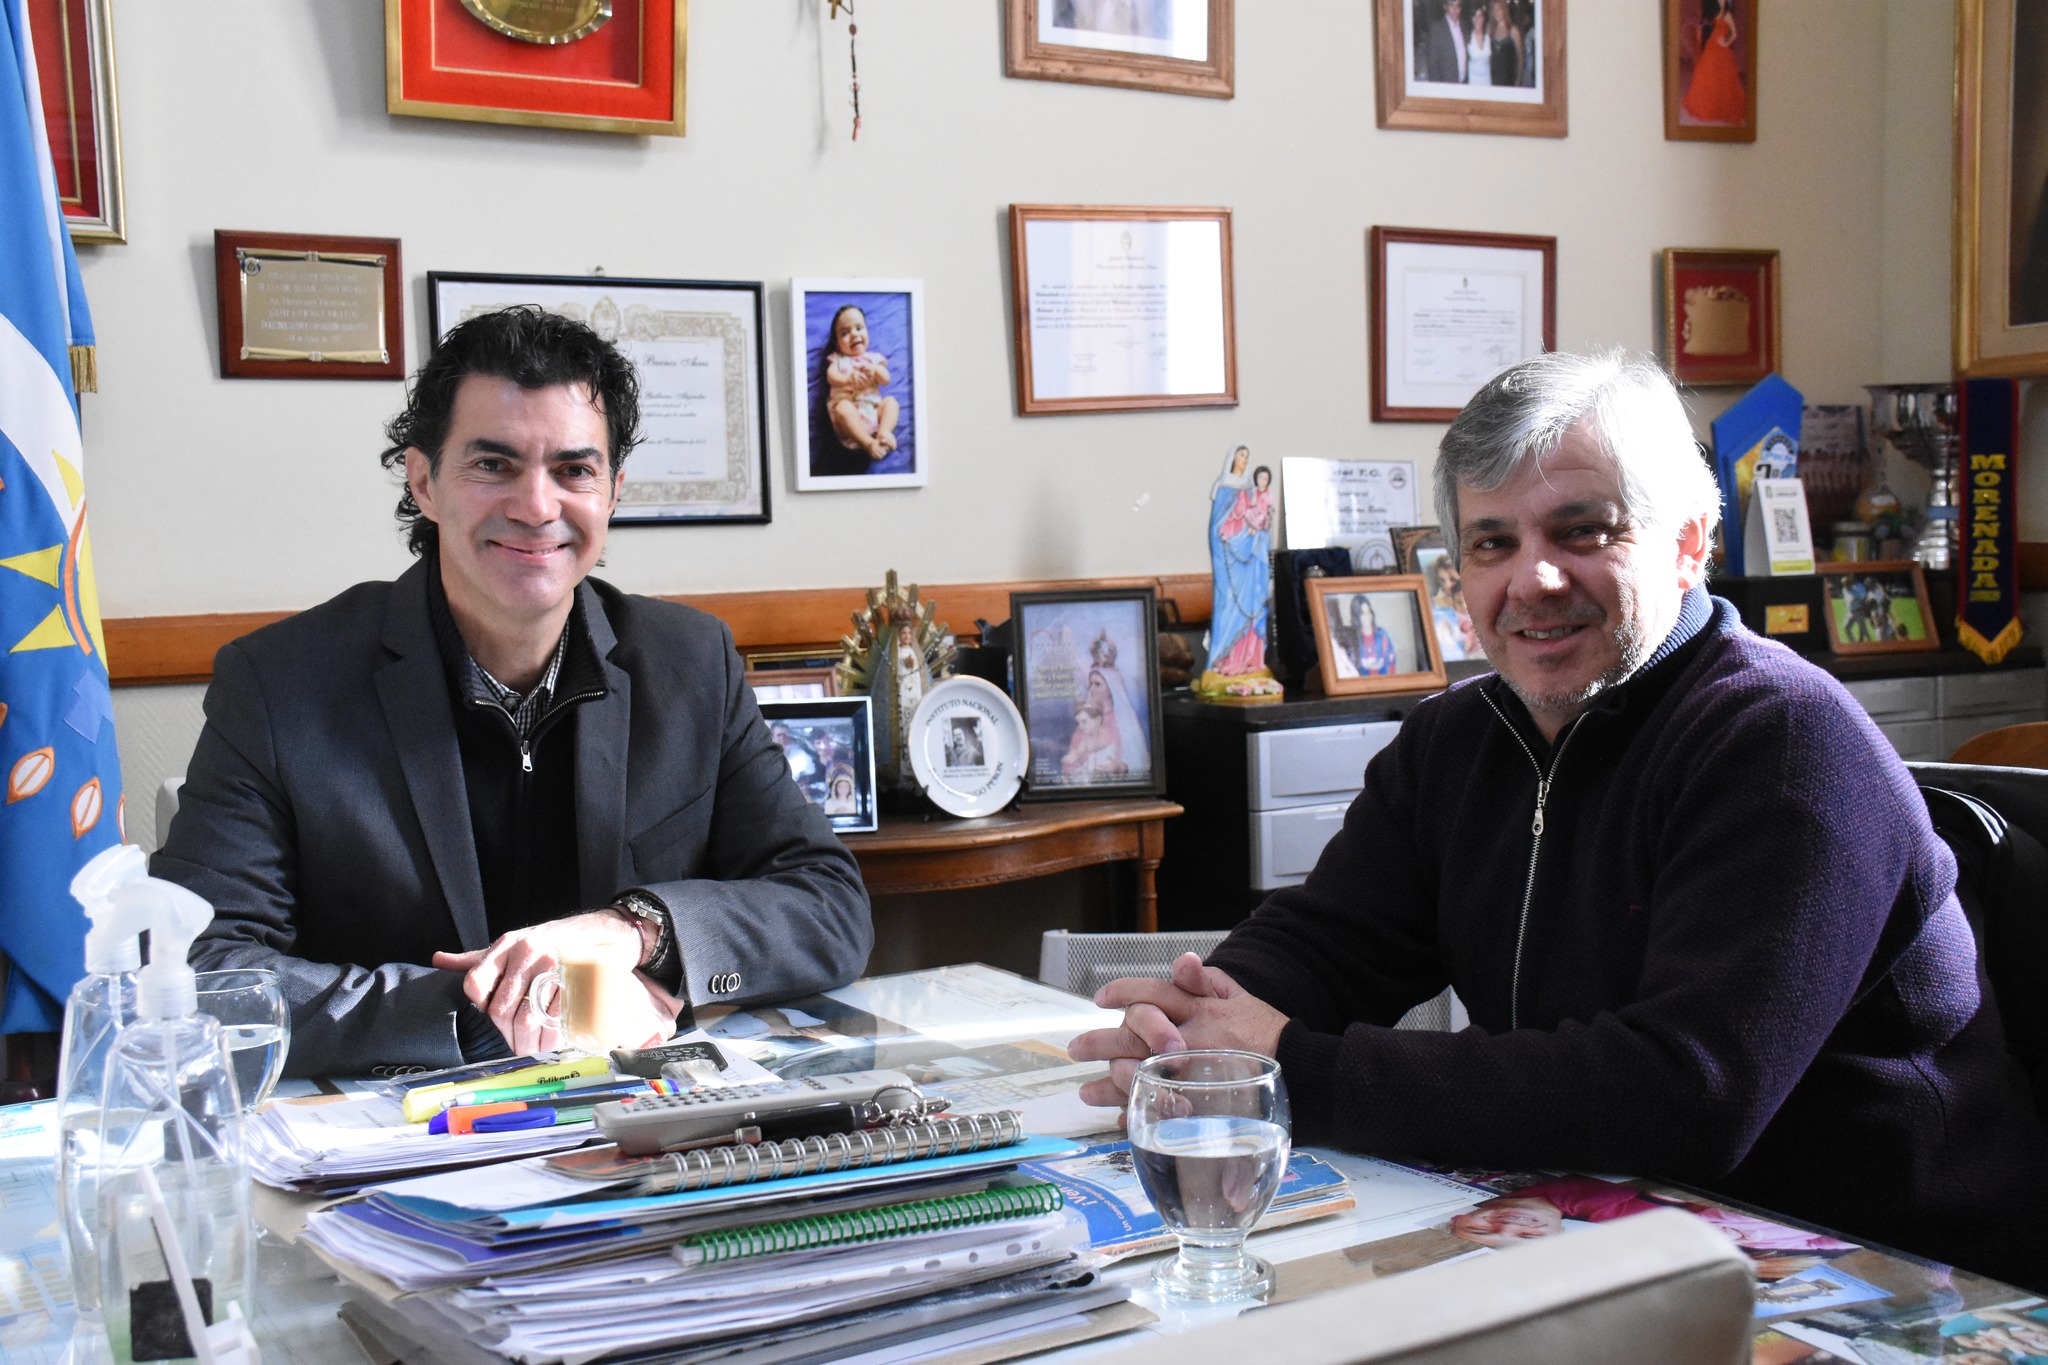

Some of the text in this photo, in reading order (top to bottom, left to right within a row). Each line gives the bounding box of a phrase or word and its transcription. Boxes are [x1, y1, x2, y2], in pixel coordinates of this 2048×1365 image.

[1970, 453, 2006, 588] MORENADA
[926, 699, 999, 726] INSTITUTO NACIONAL
[537, 1075, 570, 1085] Pelikan
[1122, 1220, 1132, 1231] Un
